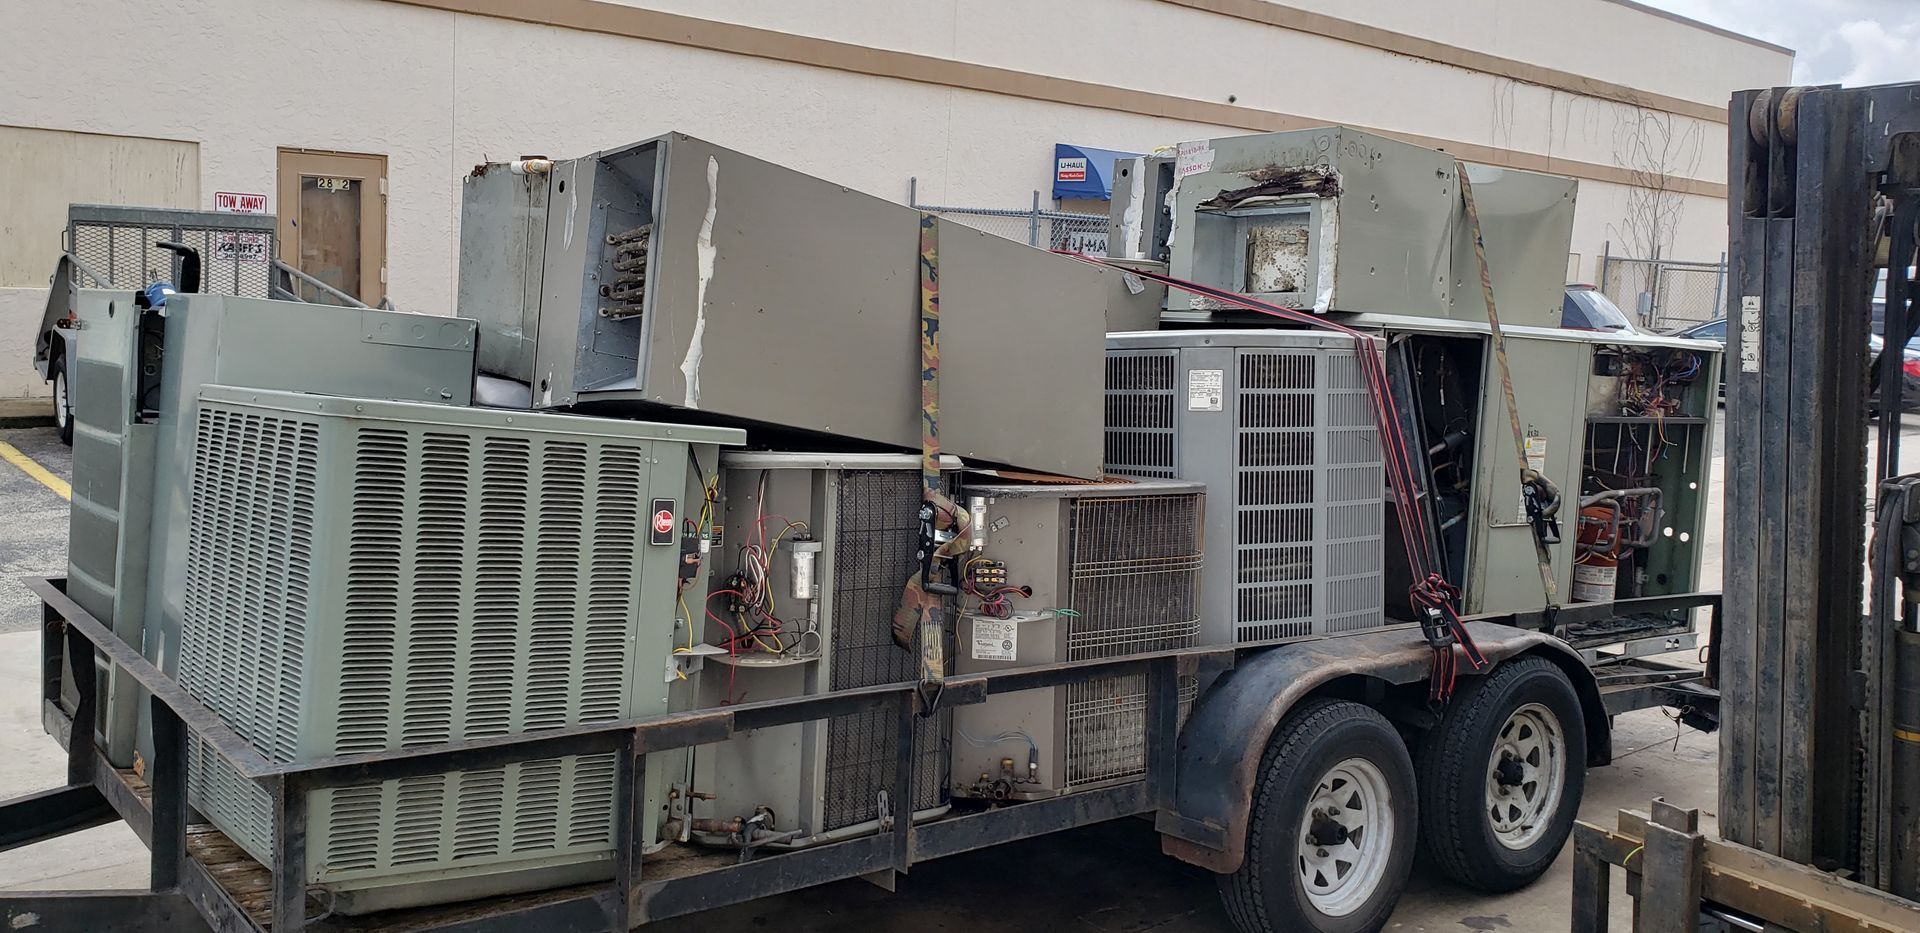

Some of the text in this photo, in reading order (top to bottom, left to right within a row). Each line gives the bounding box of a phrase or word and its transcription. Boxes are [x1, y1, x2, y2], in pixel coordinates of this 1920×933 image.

[218, 195, 264, 209] TOW AWAY
[1073, 236, 1107, 252] U-HA
